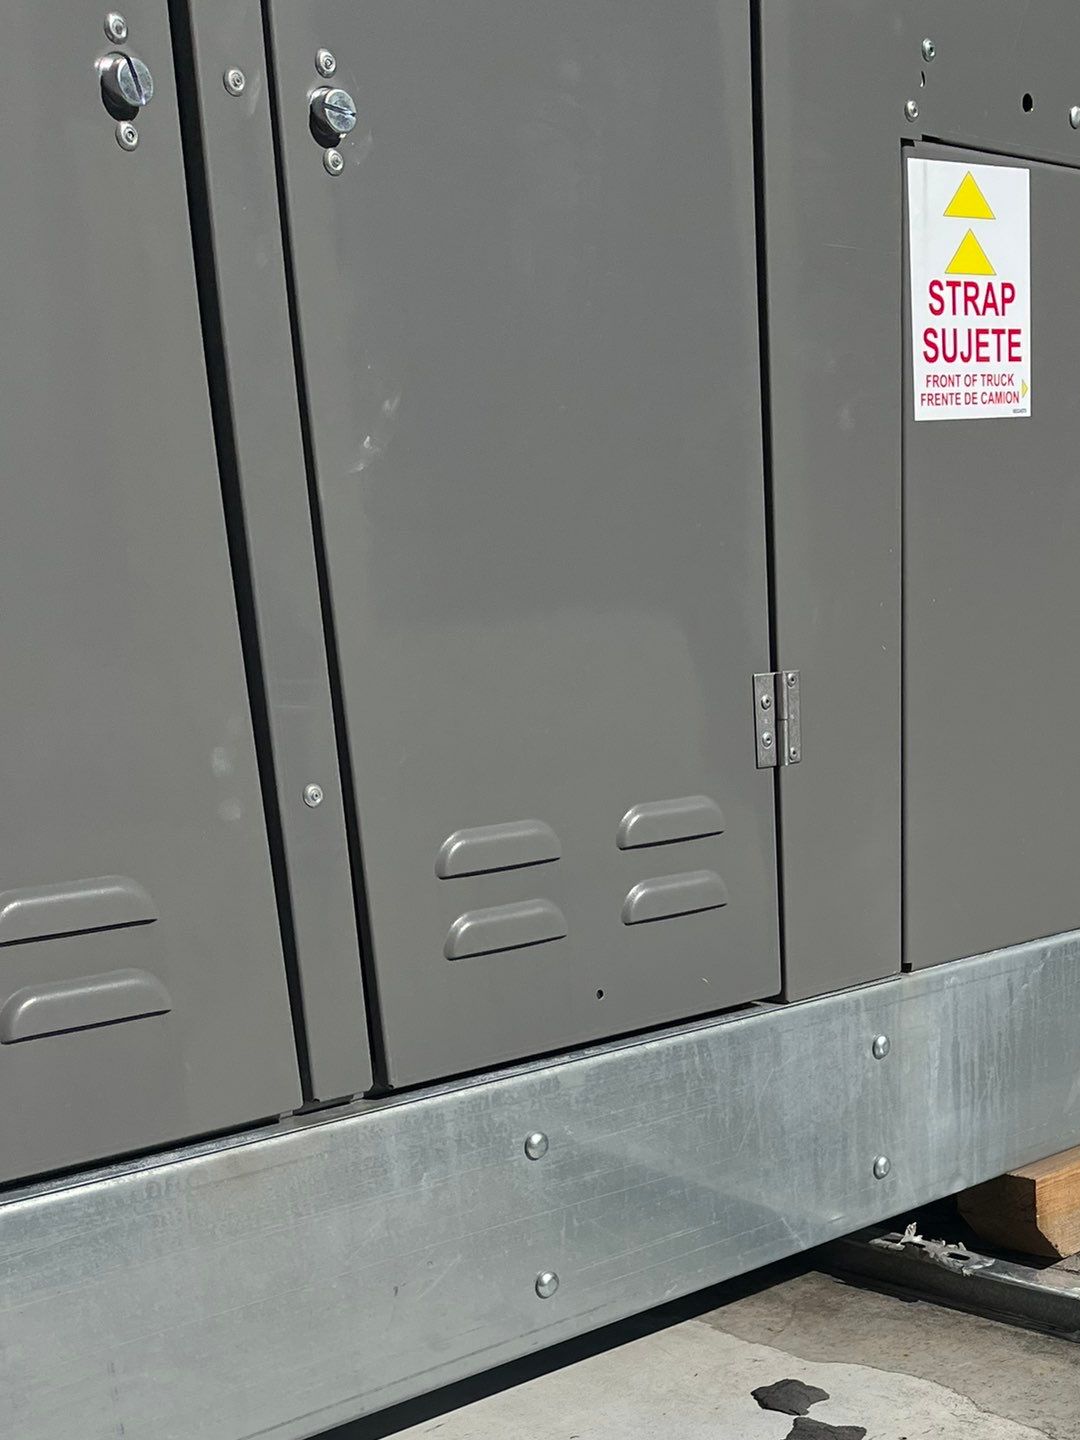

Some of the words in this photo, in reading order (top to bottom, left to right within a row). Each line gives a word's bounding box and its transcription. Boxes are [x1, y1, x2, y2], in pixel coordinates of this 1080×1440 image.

[928, 279, 1016, 316] STRAP
[922, 327, 1022, 363] SUJETE
[925, 374, 961, 388] FRONT
[964, 373, 978, 387] OF
[980, 373, 1015, 387] TRUCK
[920, 392, 962, 406] FRENTE
[964, 392, 978, 405] DE
[980, 391, 1020, 405] CAMION
